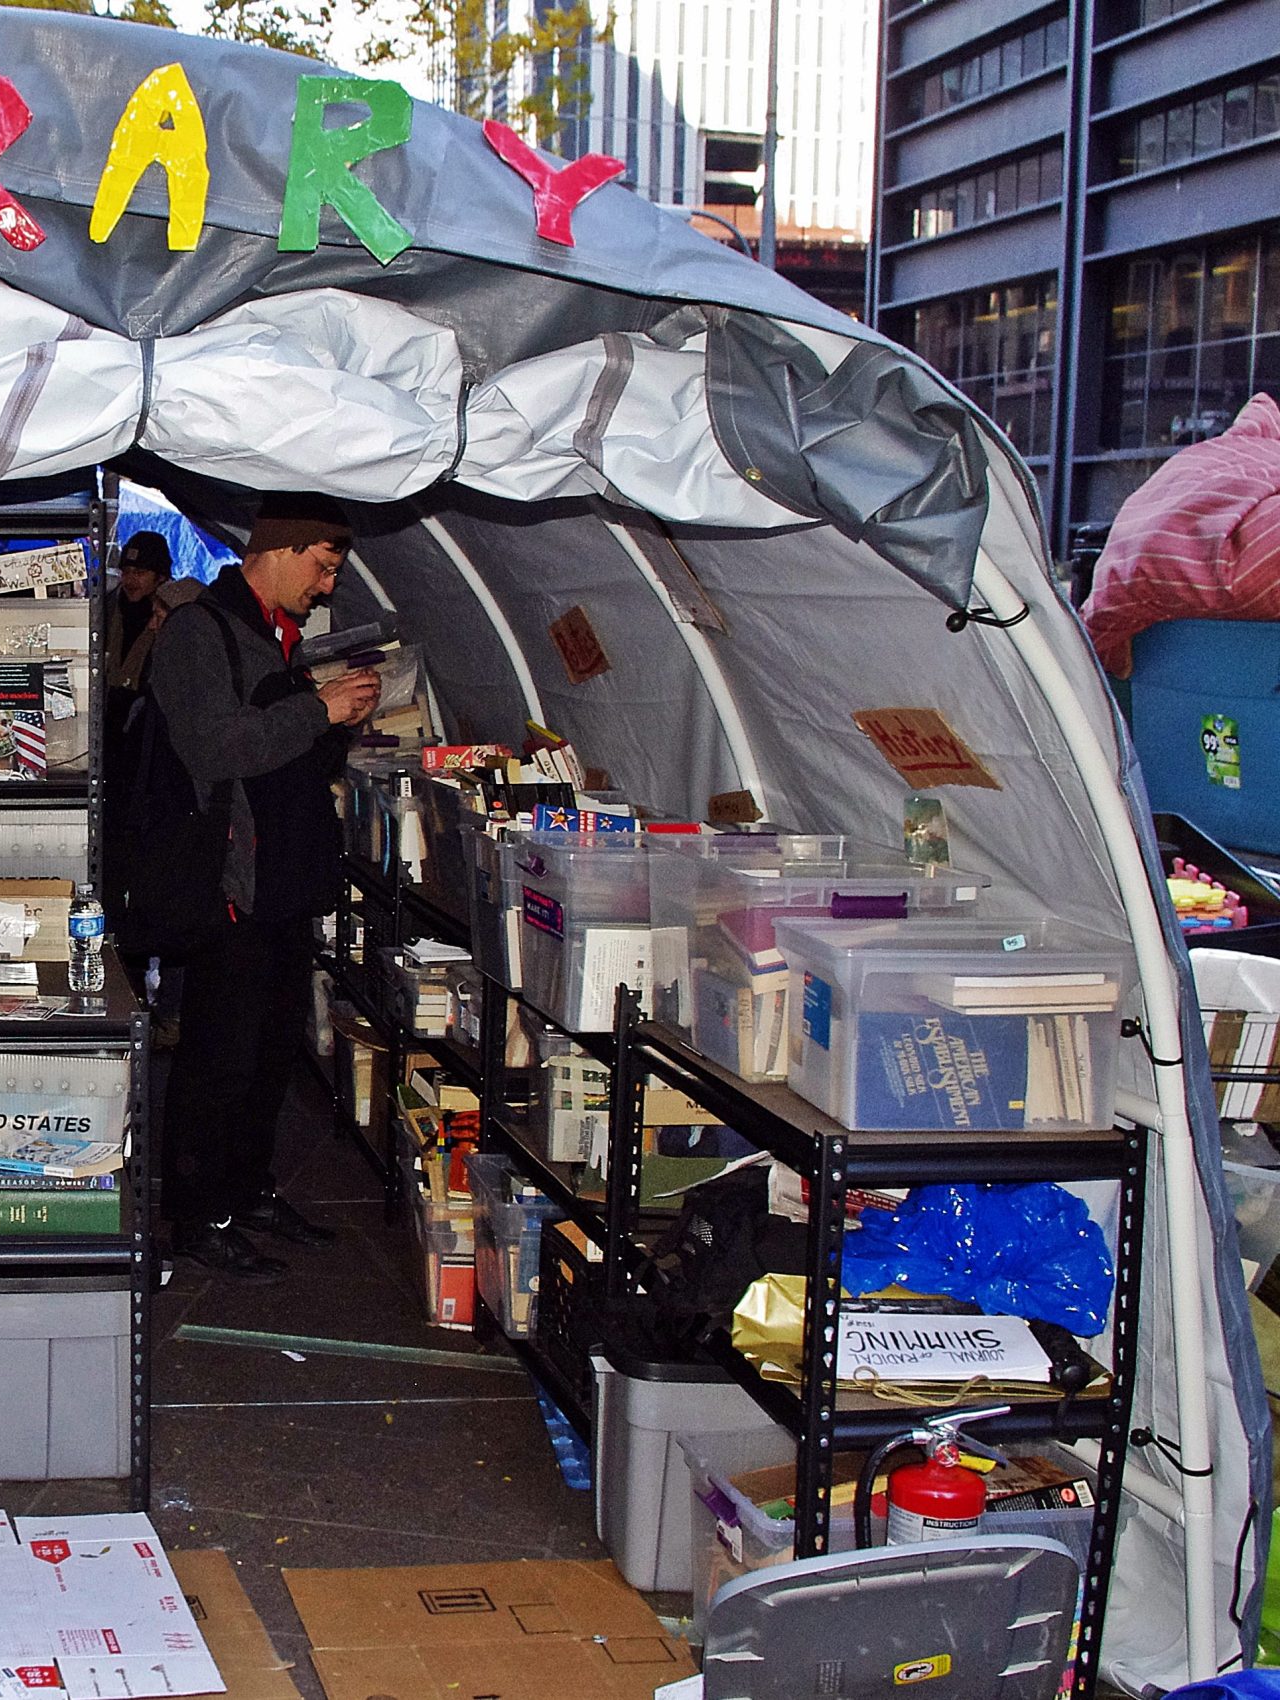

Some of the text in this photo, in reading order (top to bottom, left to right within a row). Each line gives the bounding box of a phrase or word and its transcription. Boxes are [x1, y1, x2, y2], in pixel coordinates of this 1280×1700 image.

[9, 574, 65, 589] Wellness
[866, 715, 963, 763] History
[913, 1017, 971, 1127] ESTABLISHMENT
[948, 1035, 982, 1105] AMERICAN
[969, 1050, 990, 1079] THE
[12, 1114, 91, 1133] STATES
[846, 1329, 1001, 1353] SHIMMING
[848, 1351, 918, 1365] RADICAL
[943, 1349, 1005, 1364] JOURNAL
[926, 1519, 977, 1529] INSTRUCTIONS
